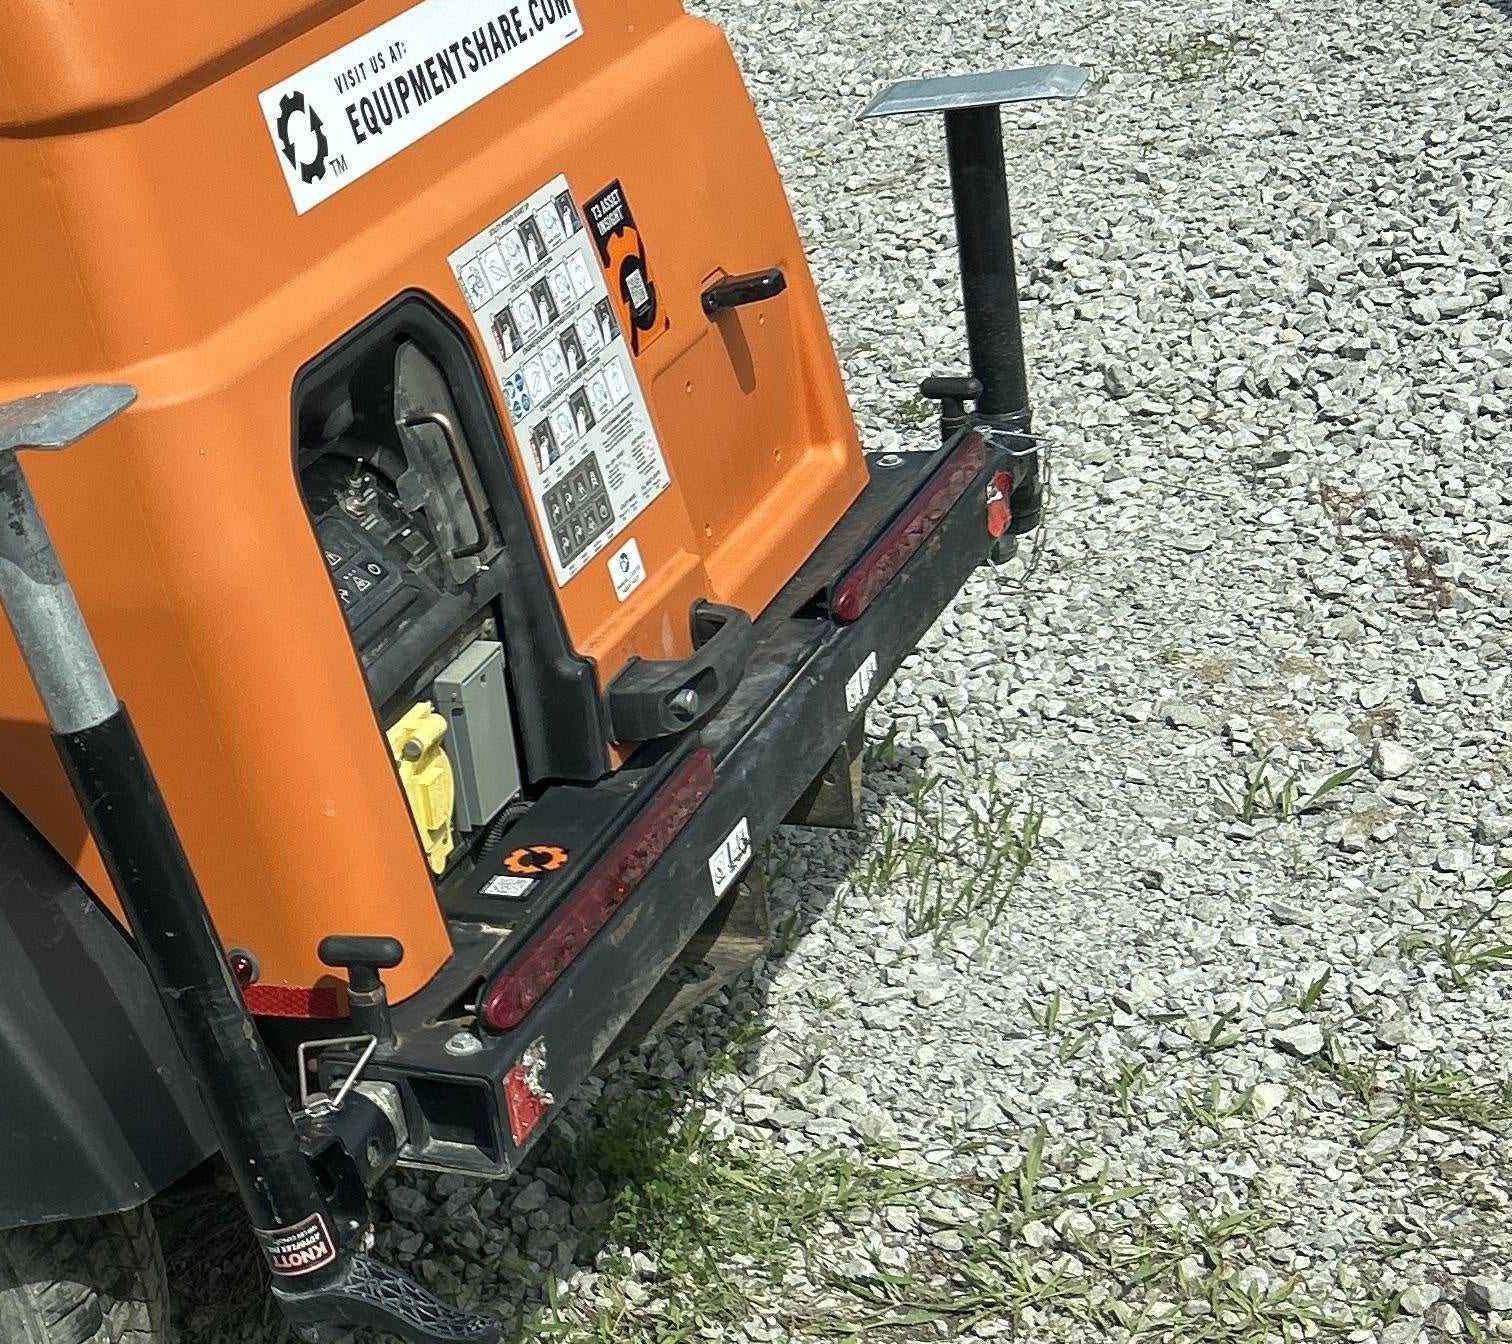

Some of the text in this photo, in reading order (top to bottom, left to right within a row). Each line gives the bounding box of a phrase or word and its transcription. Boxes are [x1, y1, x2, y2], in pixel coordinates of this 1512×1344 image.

[334, 41, 408, 94] VISIT US AT:
[600, 188, 621, 214] ASSET
[273, 1241, 328, 1268] KNOTT
